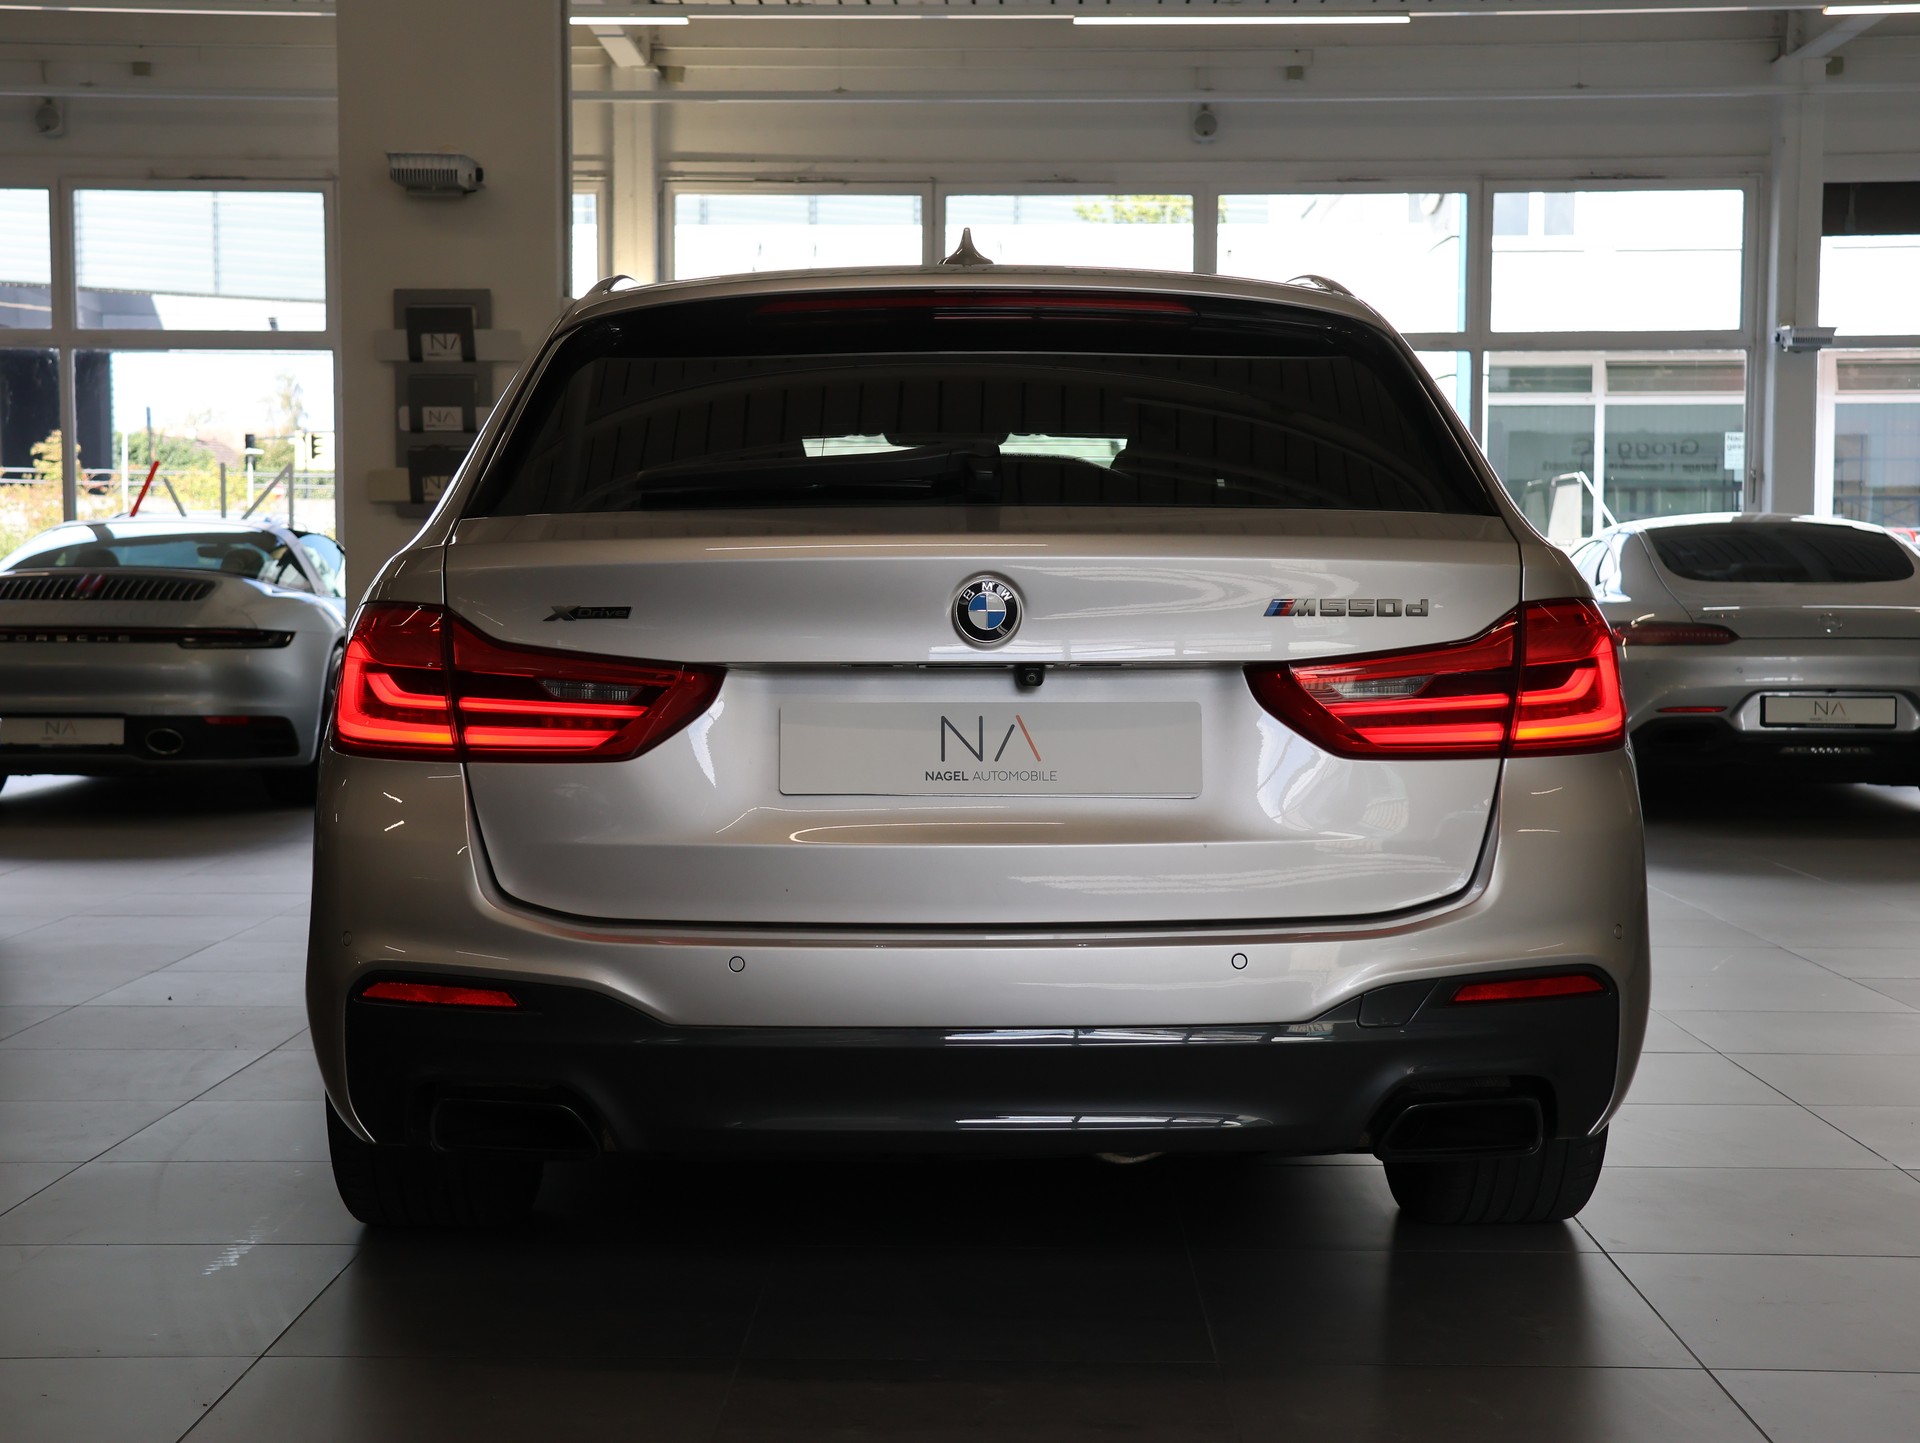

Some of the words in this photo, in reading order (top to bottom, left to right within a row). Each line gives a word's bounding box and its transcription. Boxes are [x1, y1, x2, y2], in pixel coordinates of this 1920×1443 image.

[963, 581, 1013, 601] BMW
[1814, 700, 1846, 716] NA
[940, 714, 1042, 763] NA
[925, 770, 969, 782] NAGEL
[972, 770, 1058, 782] AUTOMOBILE
